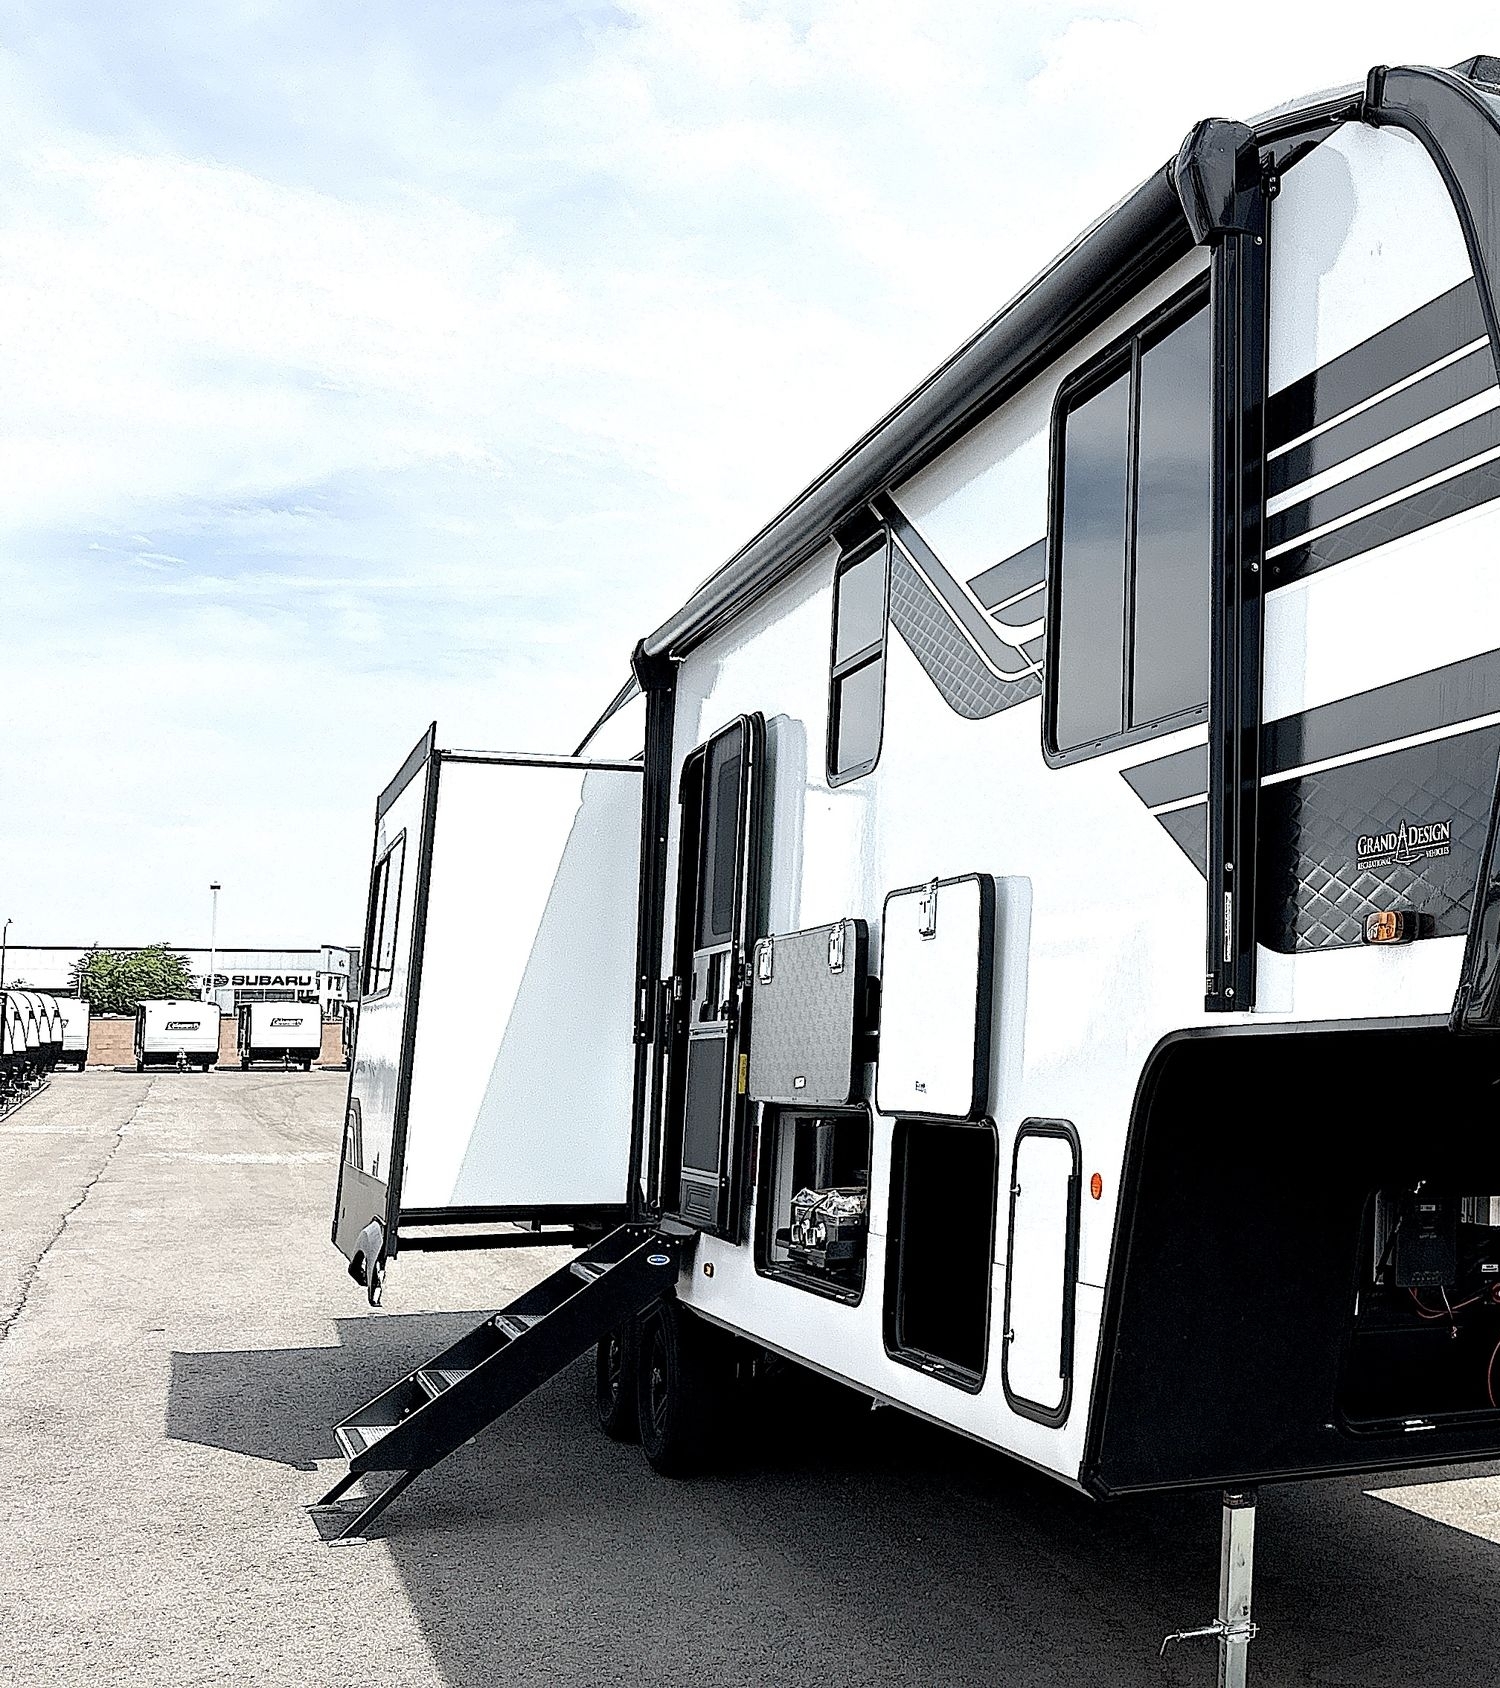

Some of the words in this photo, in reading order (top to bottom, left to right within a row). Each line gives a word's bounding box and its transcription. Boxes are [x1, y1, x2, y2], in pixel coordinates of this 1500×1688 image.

[1357, 832, 1398, 855] GRAND
[1407, 820, 1453, 846] DESIGN
[231, 975, 312, 986] SUBARU
